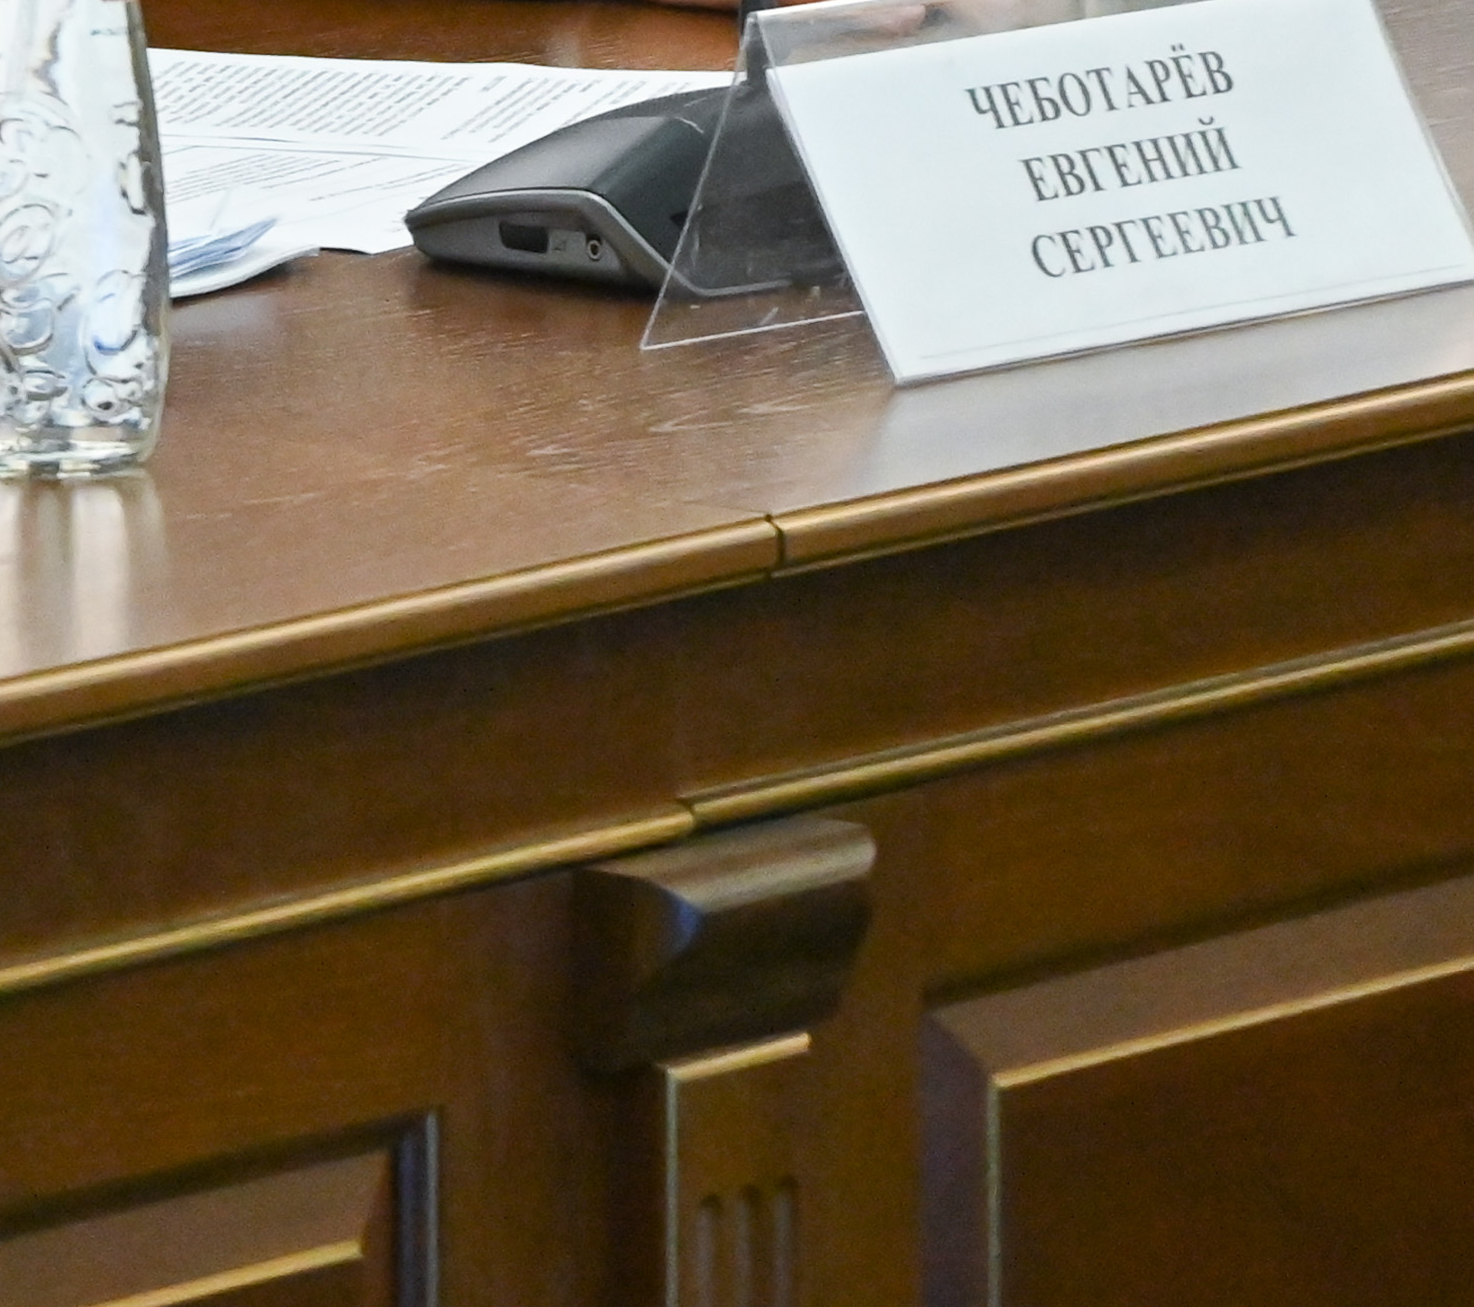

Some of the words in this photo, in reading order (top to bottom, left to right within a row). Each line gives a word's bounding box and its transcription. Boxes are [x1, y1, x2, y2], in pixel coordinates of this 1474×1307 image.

[964, 44, 1236, 131] ЧЕБОТАРЁВ
[1019, 117, 1241, 204] ЕВГЕНИЙ
[1029, 196, 1297, 280] СЕРГЕЕВИЧ
